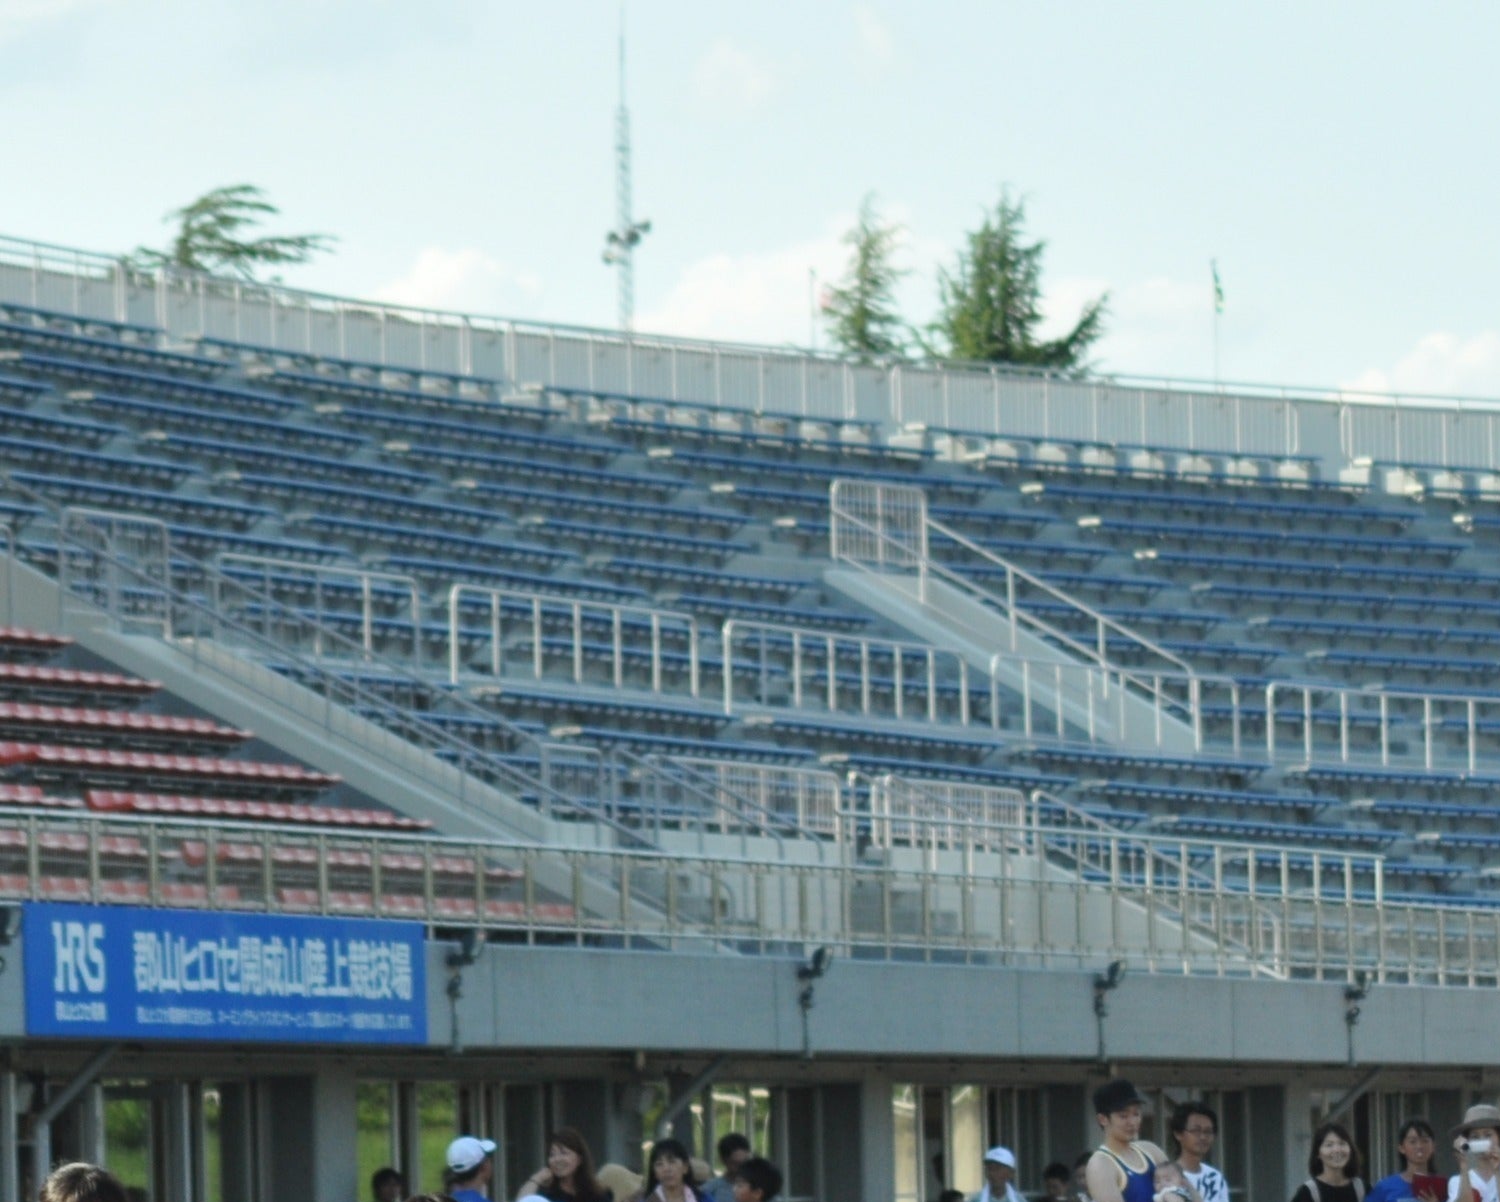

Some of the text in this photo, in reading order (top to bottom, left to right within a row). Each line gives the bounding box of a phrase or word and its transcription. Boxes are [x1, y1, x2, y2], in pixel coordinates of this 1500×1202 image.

[52, 921, 106, 993] HRS
[133, 931, 413, 1000] 郡山ヒロセ開成山陸上競技場
